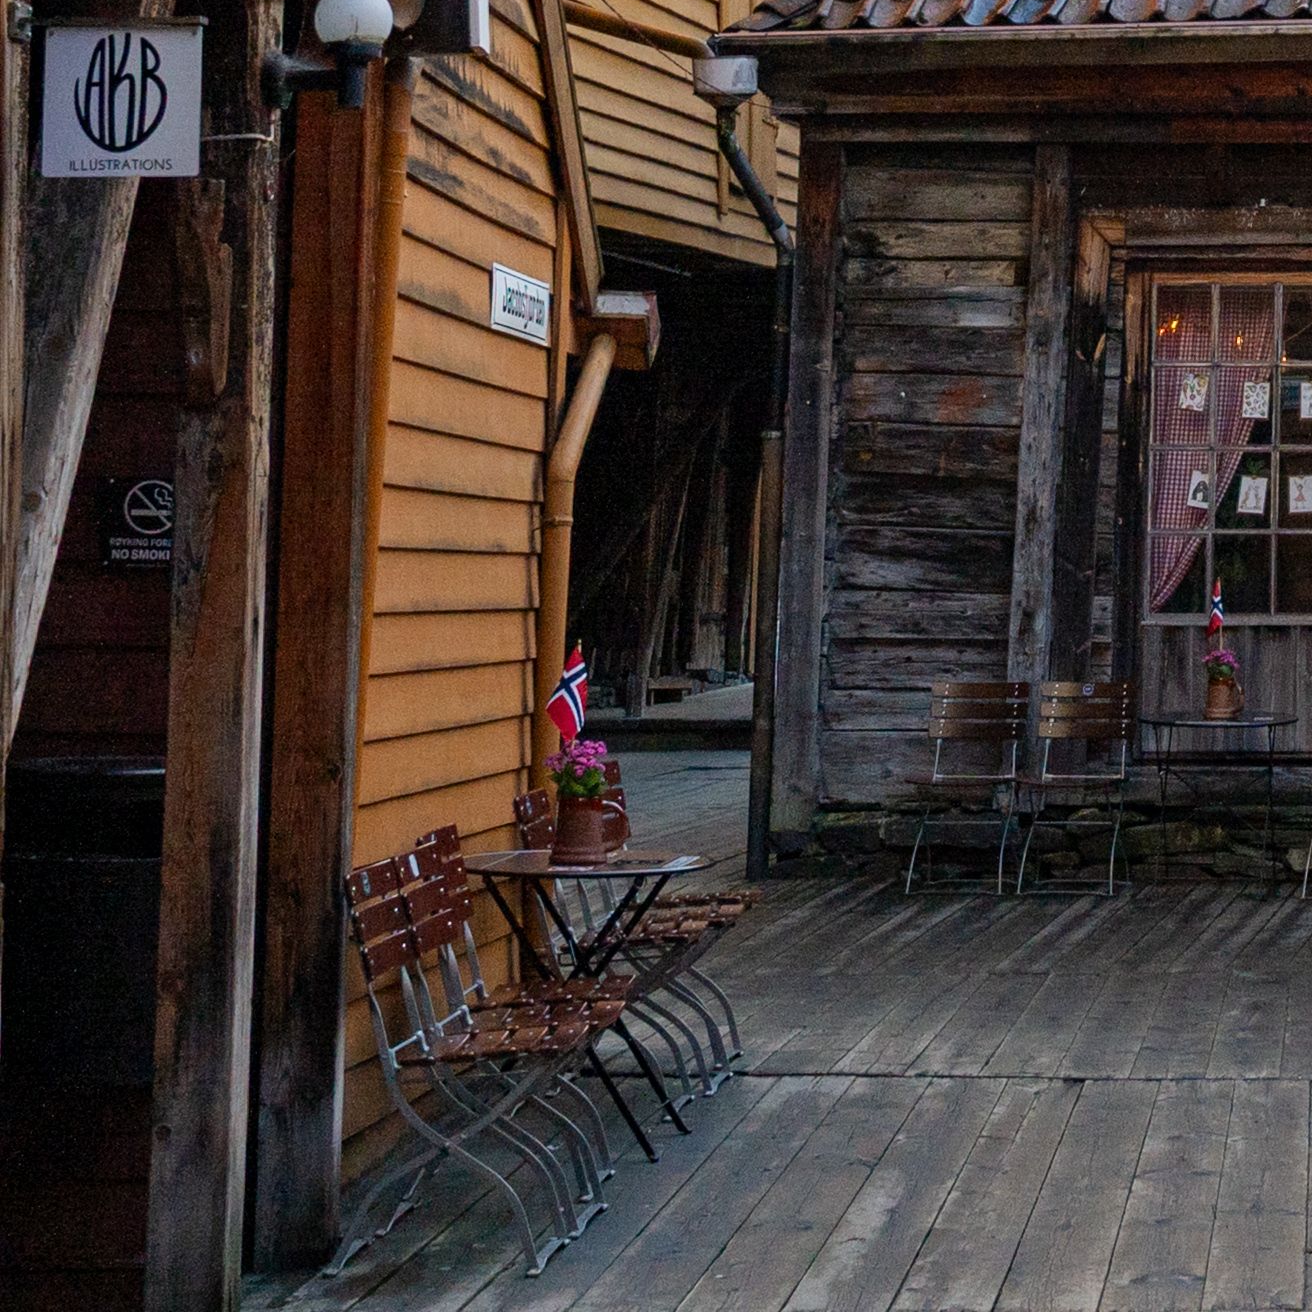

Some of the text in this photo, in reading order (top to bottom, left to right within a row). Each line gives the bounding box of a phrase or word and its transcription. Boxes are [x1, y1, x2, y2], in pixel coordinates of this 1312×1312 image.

[74, 33, 168, 153] AKB
[69, 159, 173, 171] ILLUSTRATIONS
[111, 548, 171, 560] NO SMOKI
